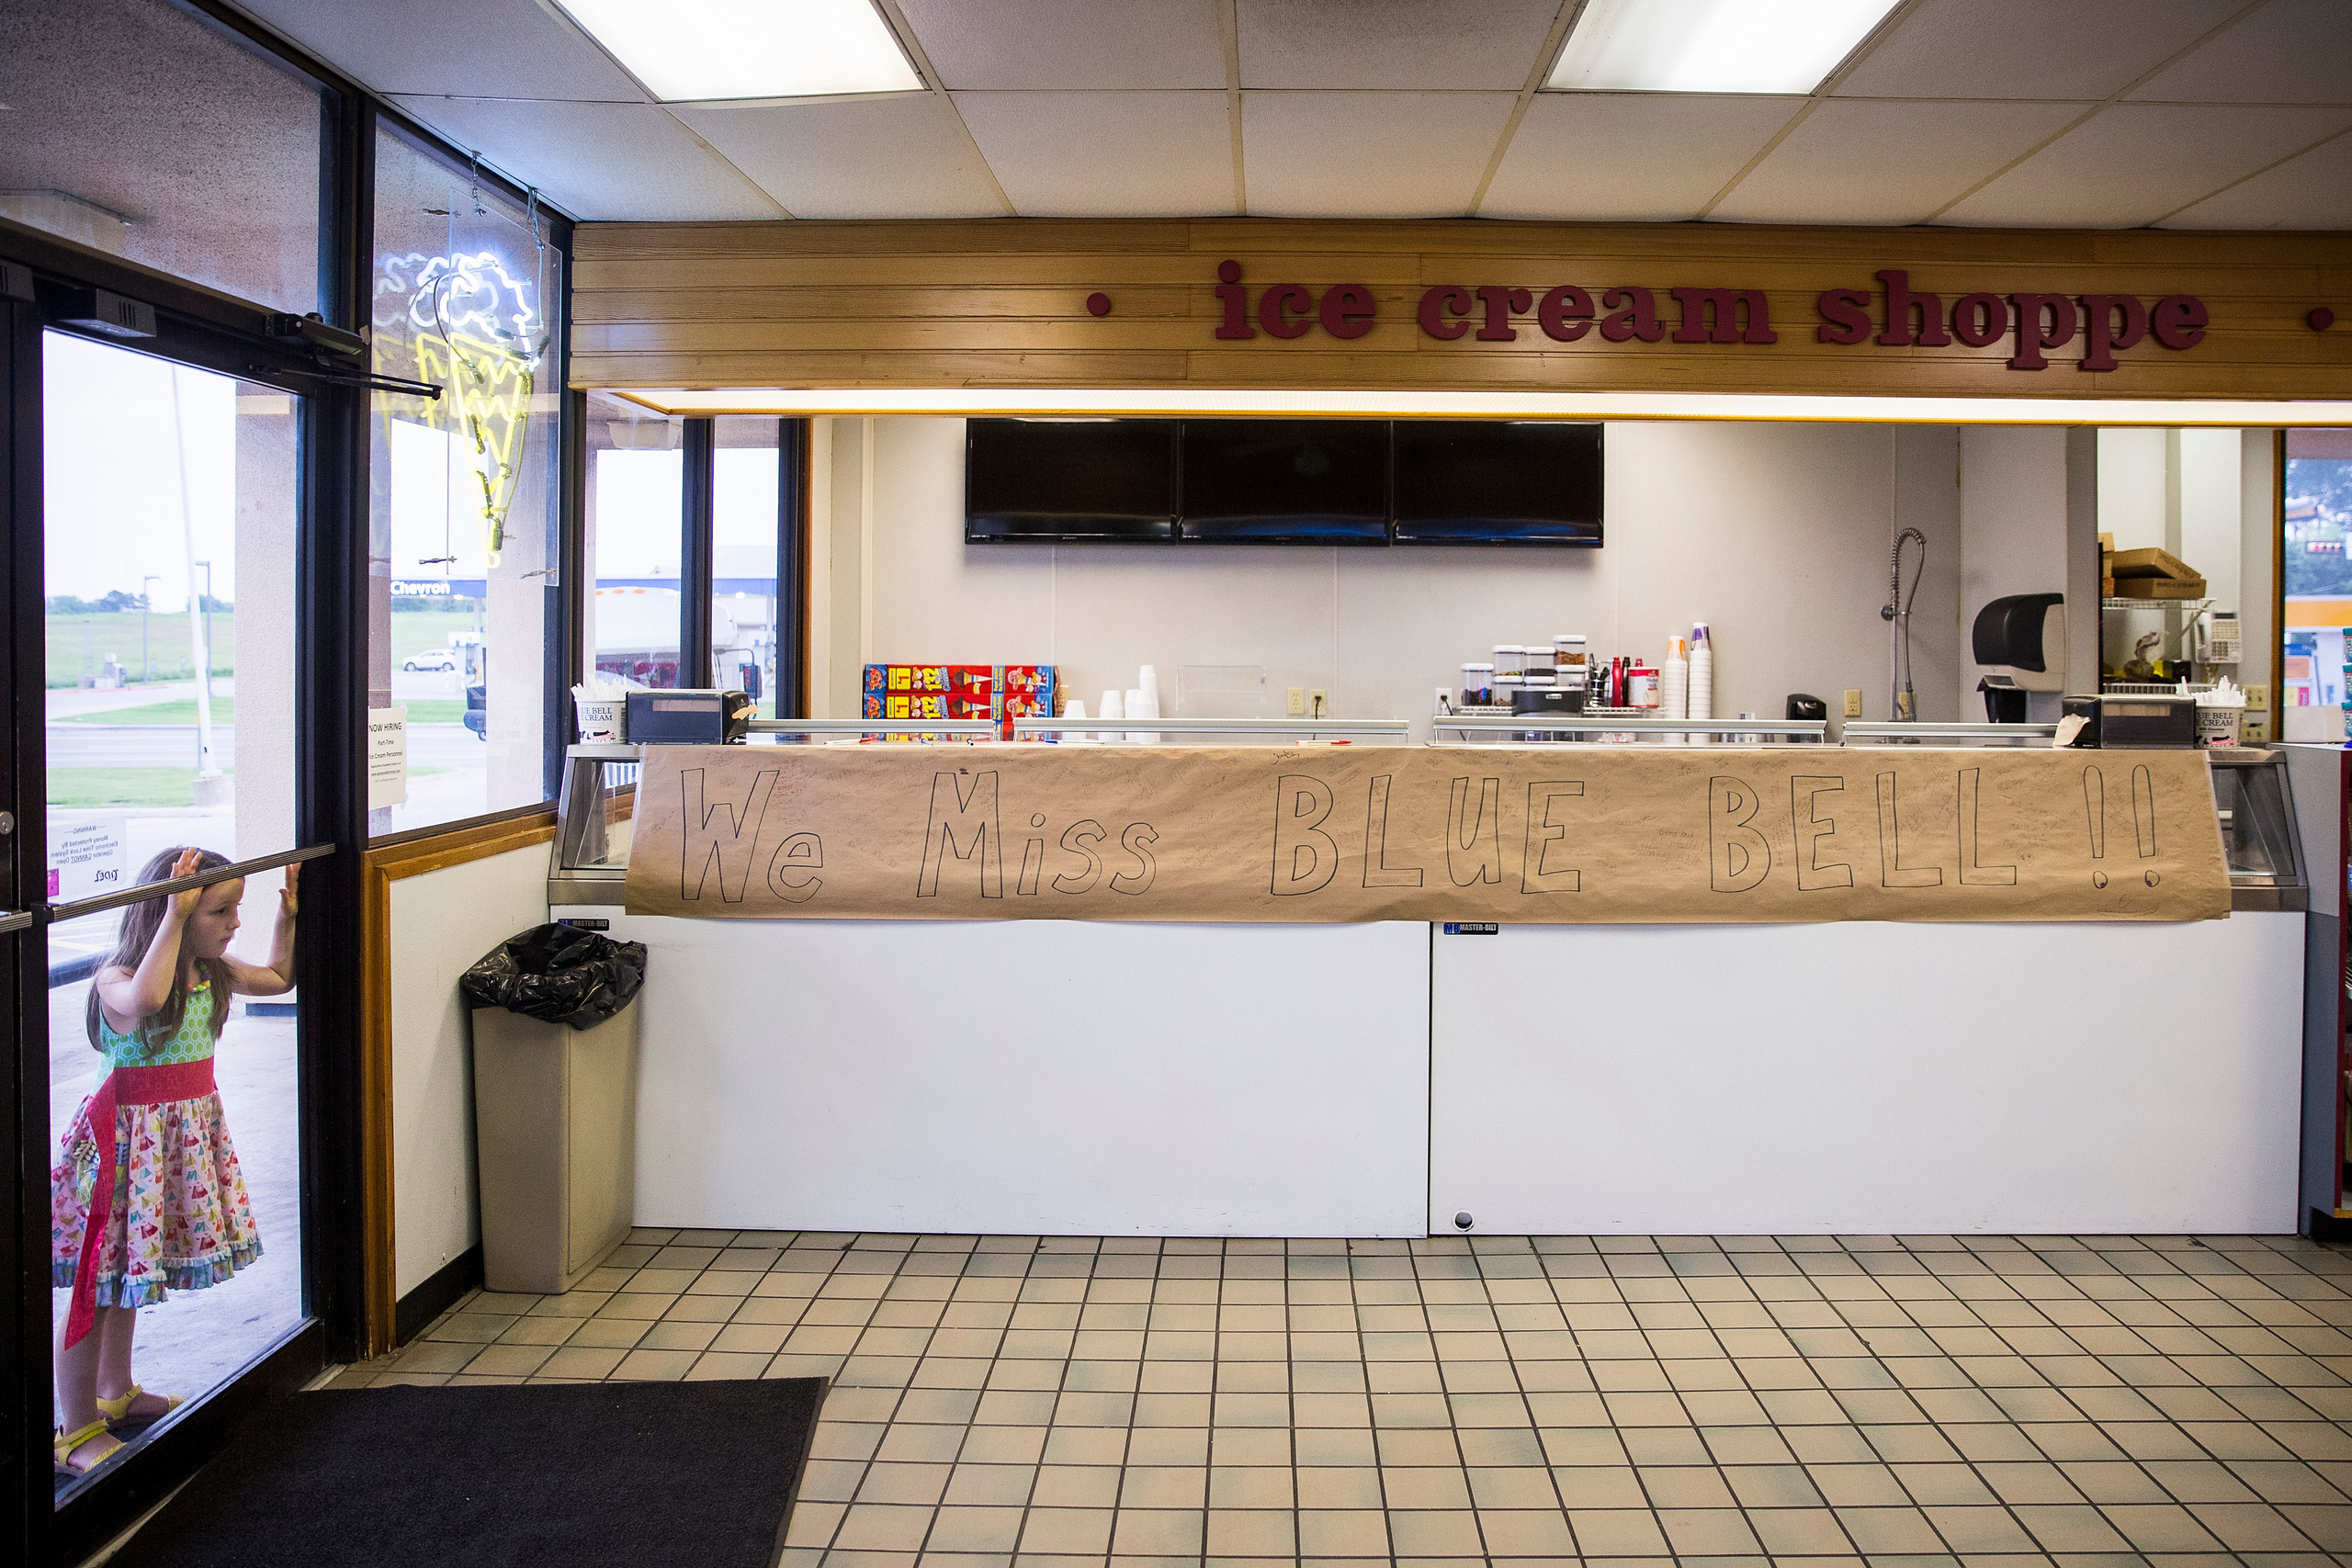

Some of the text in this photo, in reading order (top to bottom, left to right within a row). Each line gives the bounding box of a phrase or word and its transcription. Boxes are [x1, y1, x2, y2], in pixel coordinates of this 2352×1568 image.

[1216, 260, 2210, 372] ice cream shoppe
[390, 581, 451, 595] Chevron
[869, 667, 883, 690] JOY
[922, 668, 943, 692] 132
[940, 666, 951, 692] Cones
[866, 695, 881, 719] JOY
[921, 695, 941, 719] 132
[939, 695, 950, 719] Cones
[369, 722, 401, 733] NOW HIRING
[681, 767, 823, 903] We
[916, 770, 1161, 899] Miss
[1271, 773, 1586, 897] BLUE
[1708, 766, 2018, 894] BELL
[1460, 923, 1498, 931] MASTER-BILT
